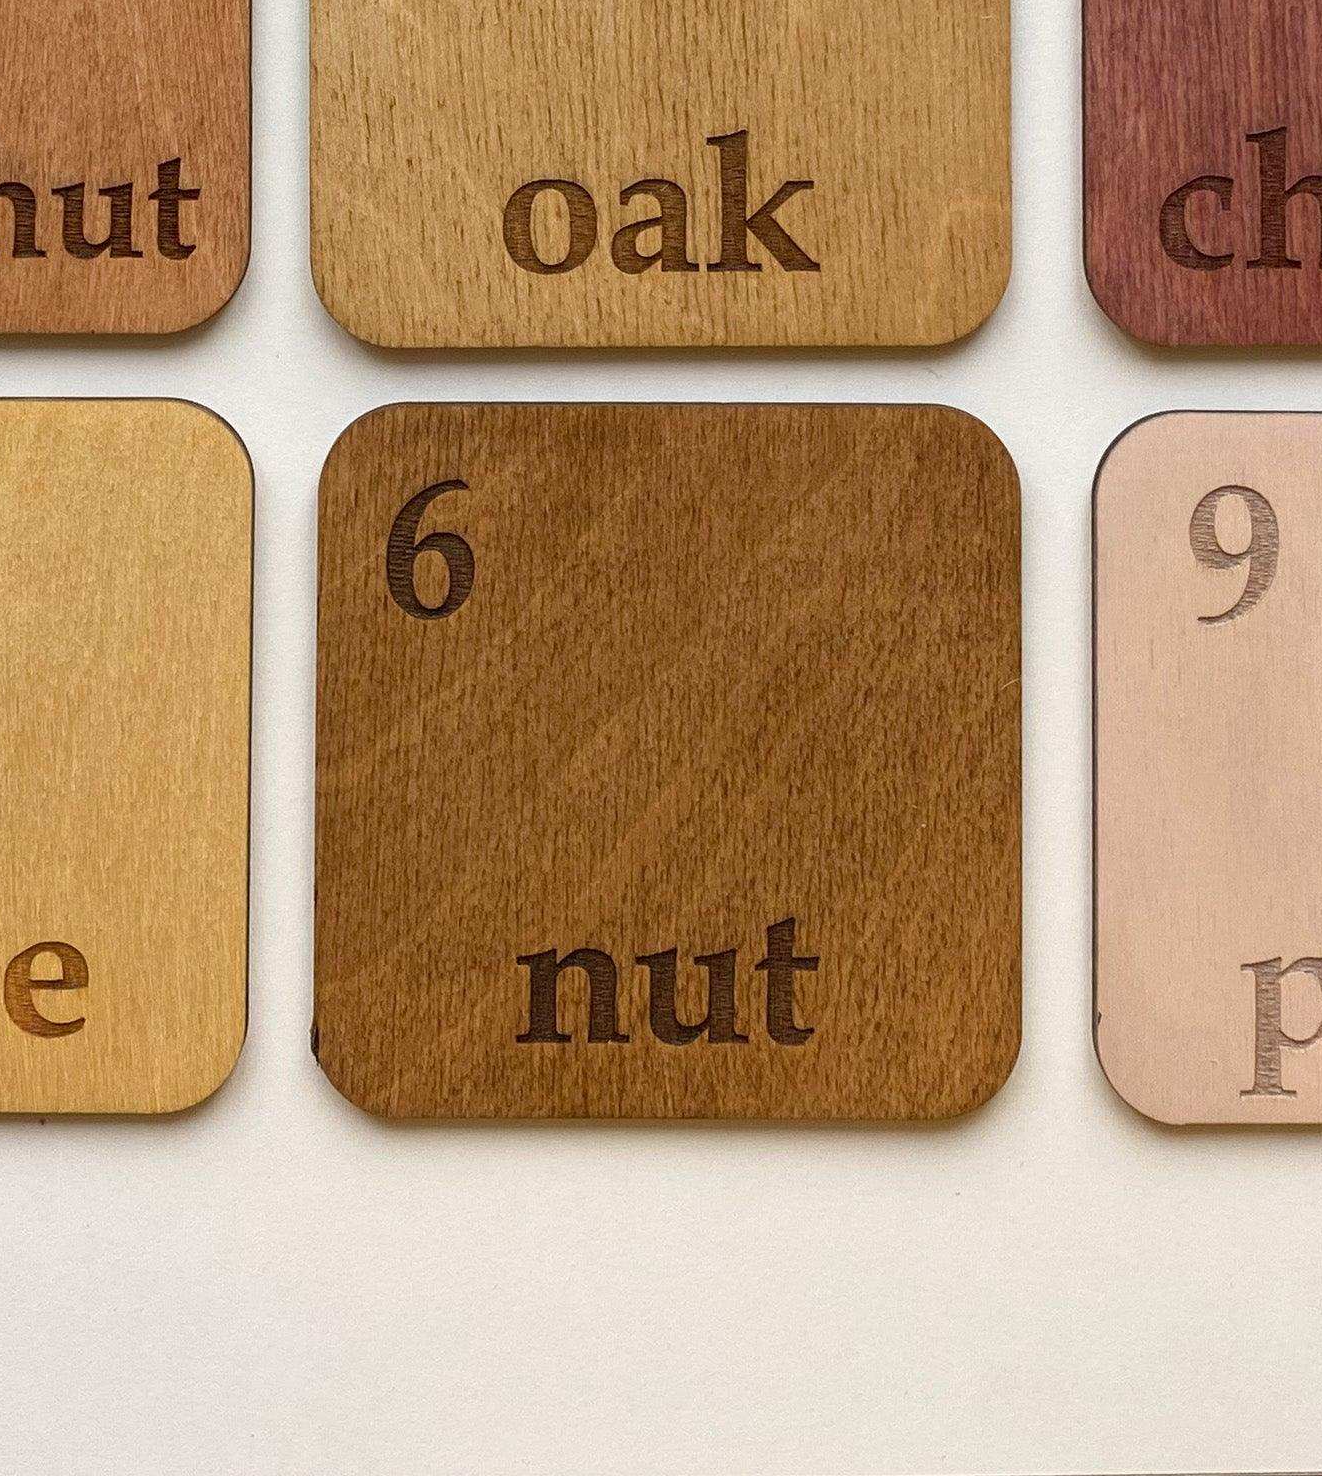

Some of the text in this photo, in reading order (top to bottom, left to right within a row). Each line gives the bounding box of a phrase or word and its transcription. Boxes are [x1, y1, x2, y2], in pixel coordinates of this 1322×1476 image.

[503, 128, 821, 275] oak
[386, 476, 475, 620] 6
[1189, 482, 1279, 626] 9
[515, 916, 819, 1045] nut
